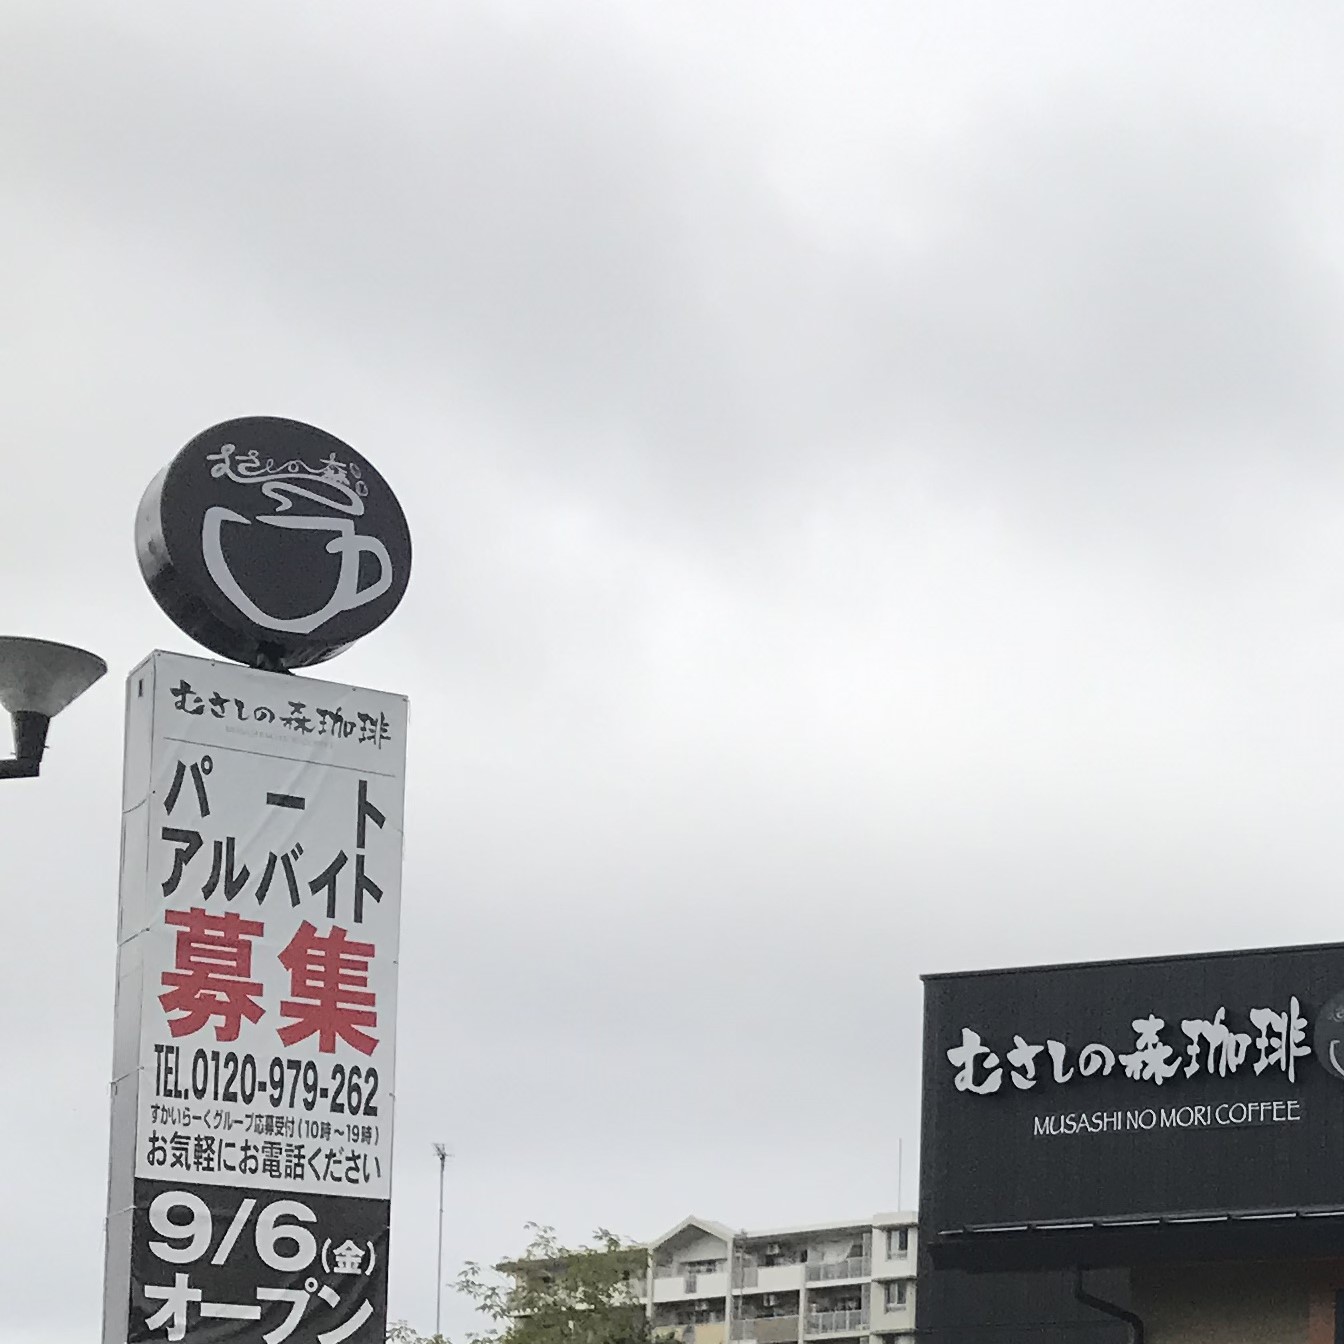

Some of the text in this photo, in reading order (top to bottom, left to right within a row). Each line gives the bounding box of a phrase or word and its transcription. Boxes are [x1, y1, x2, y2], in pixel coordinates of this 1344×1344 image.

[170, 680, 391, 750] むさしの森珈琲
[161, 827, 384, 923] アルバイト
[157, 907, 380, 1057] 募集
[154, 1044, 379, 1117] TEL.0120-979-262
[946, 996, 1311, 1095] むさしの森珈琲
[1034, 1100, 1300, 1136] MUSASHI NO MORI COFFEE
[146, 1130, 381, 1184] お気軽にお電話ください
